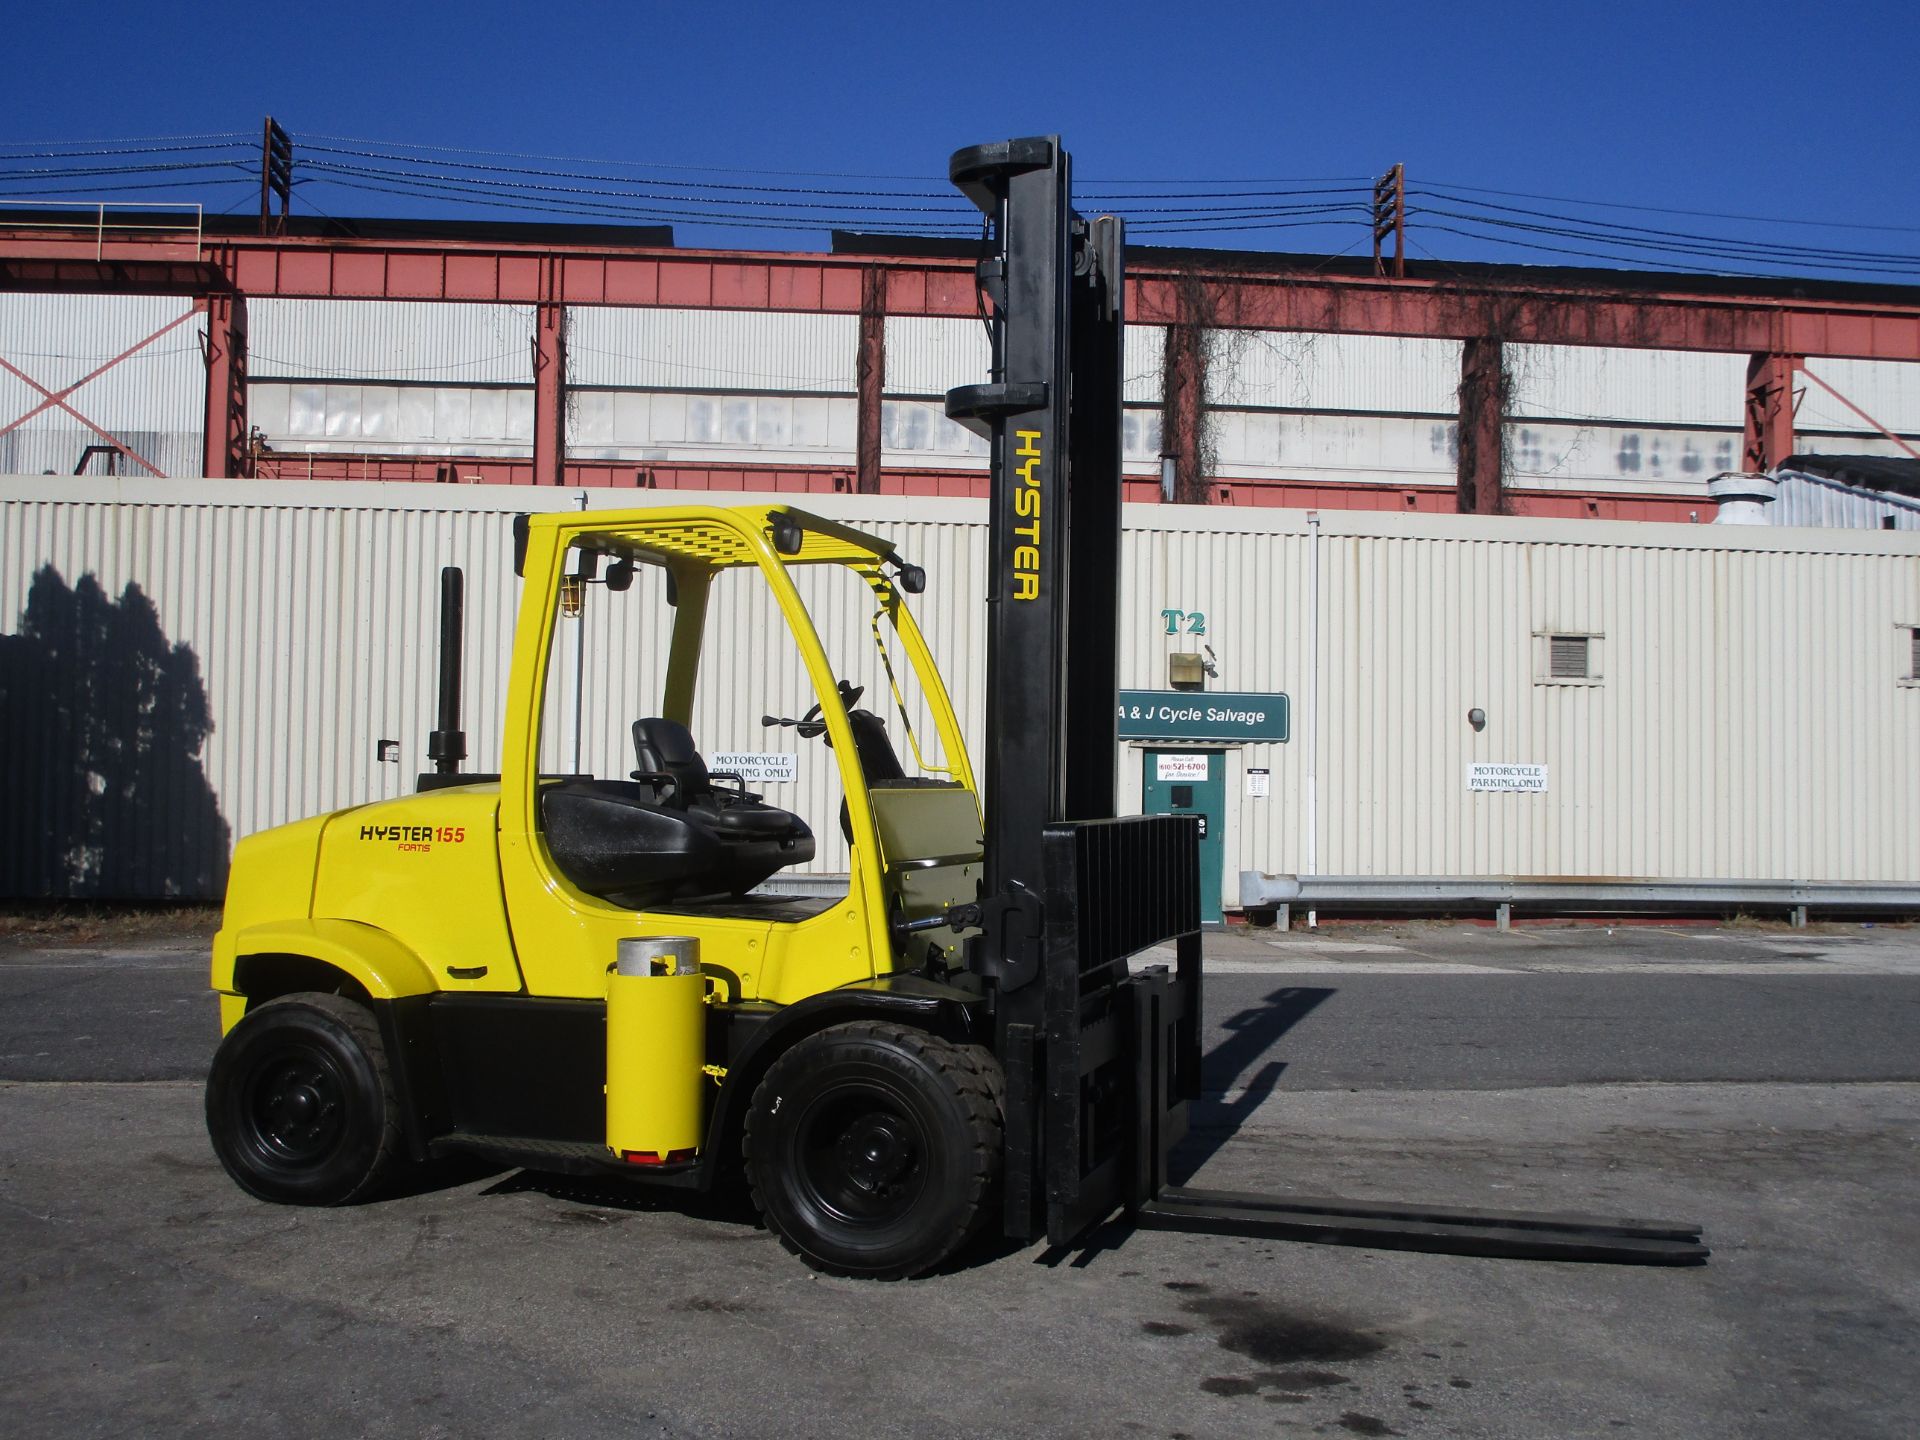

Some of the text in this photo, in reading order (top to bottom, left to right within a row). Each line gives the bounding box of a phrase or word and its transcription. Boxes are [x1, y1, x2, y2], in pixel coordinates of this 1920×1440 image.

[1013, 430, 1041, 601] HYSTER
[1130, 706, 1141, 719] &
[1145, 707, 1155, 719] J
[1159, 707, 1202, 724] Cycle
[1206, 708, 1265, 725] Salvage
[715, 756, 788, 766] MOTORCYCLE
[764, 769, 792, 778] ONLY
[1473, 767, 1541, 777] MOTORCYCLE
[1471, 778, 1544, 788] PARKING ONLY
[360, 825, 465, 843] HYSTER 155
[397, 844, 431, 853] FORTIS
